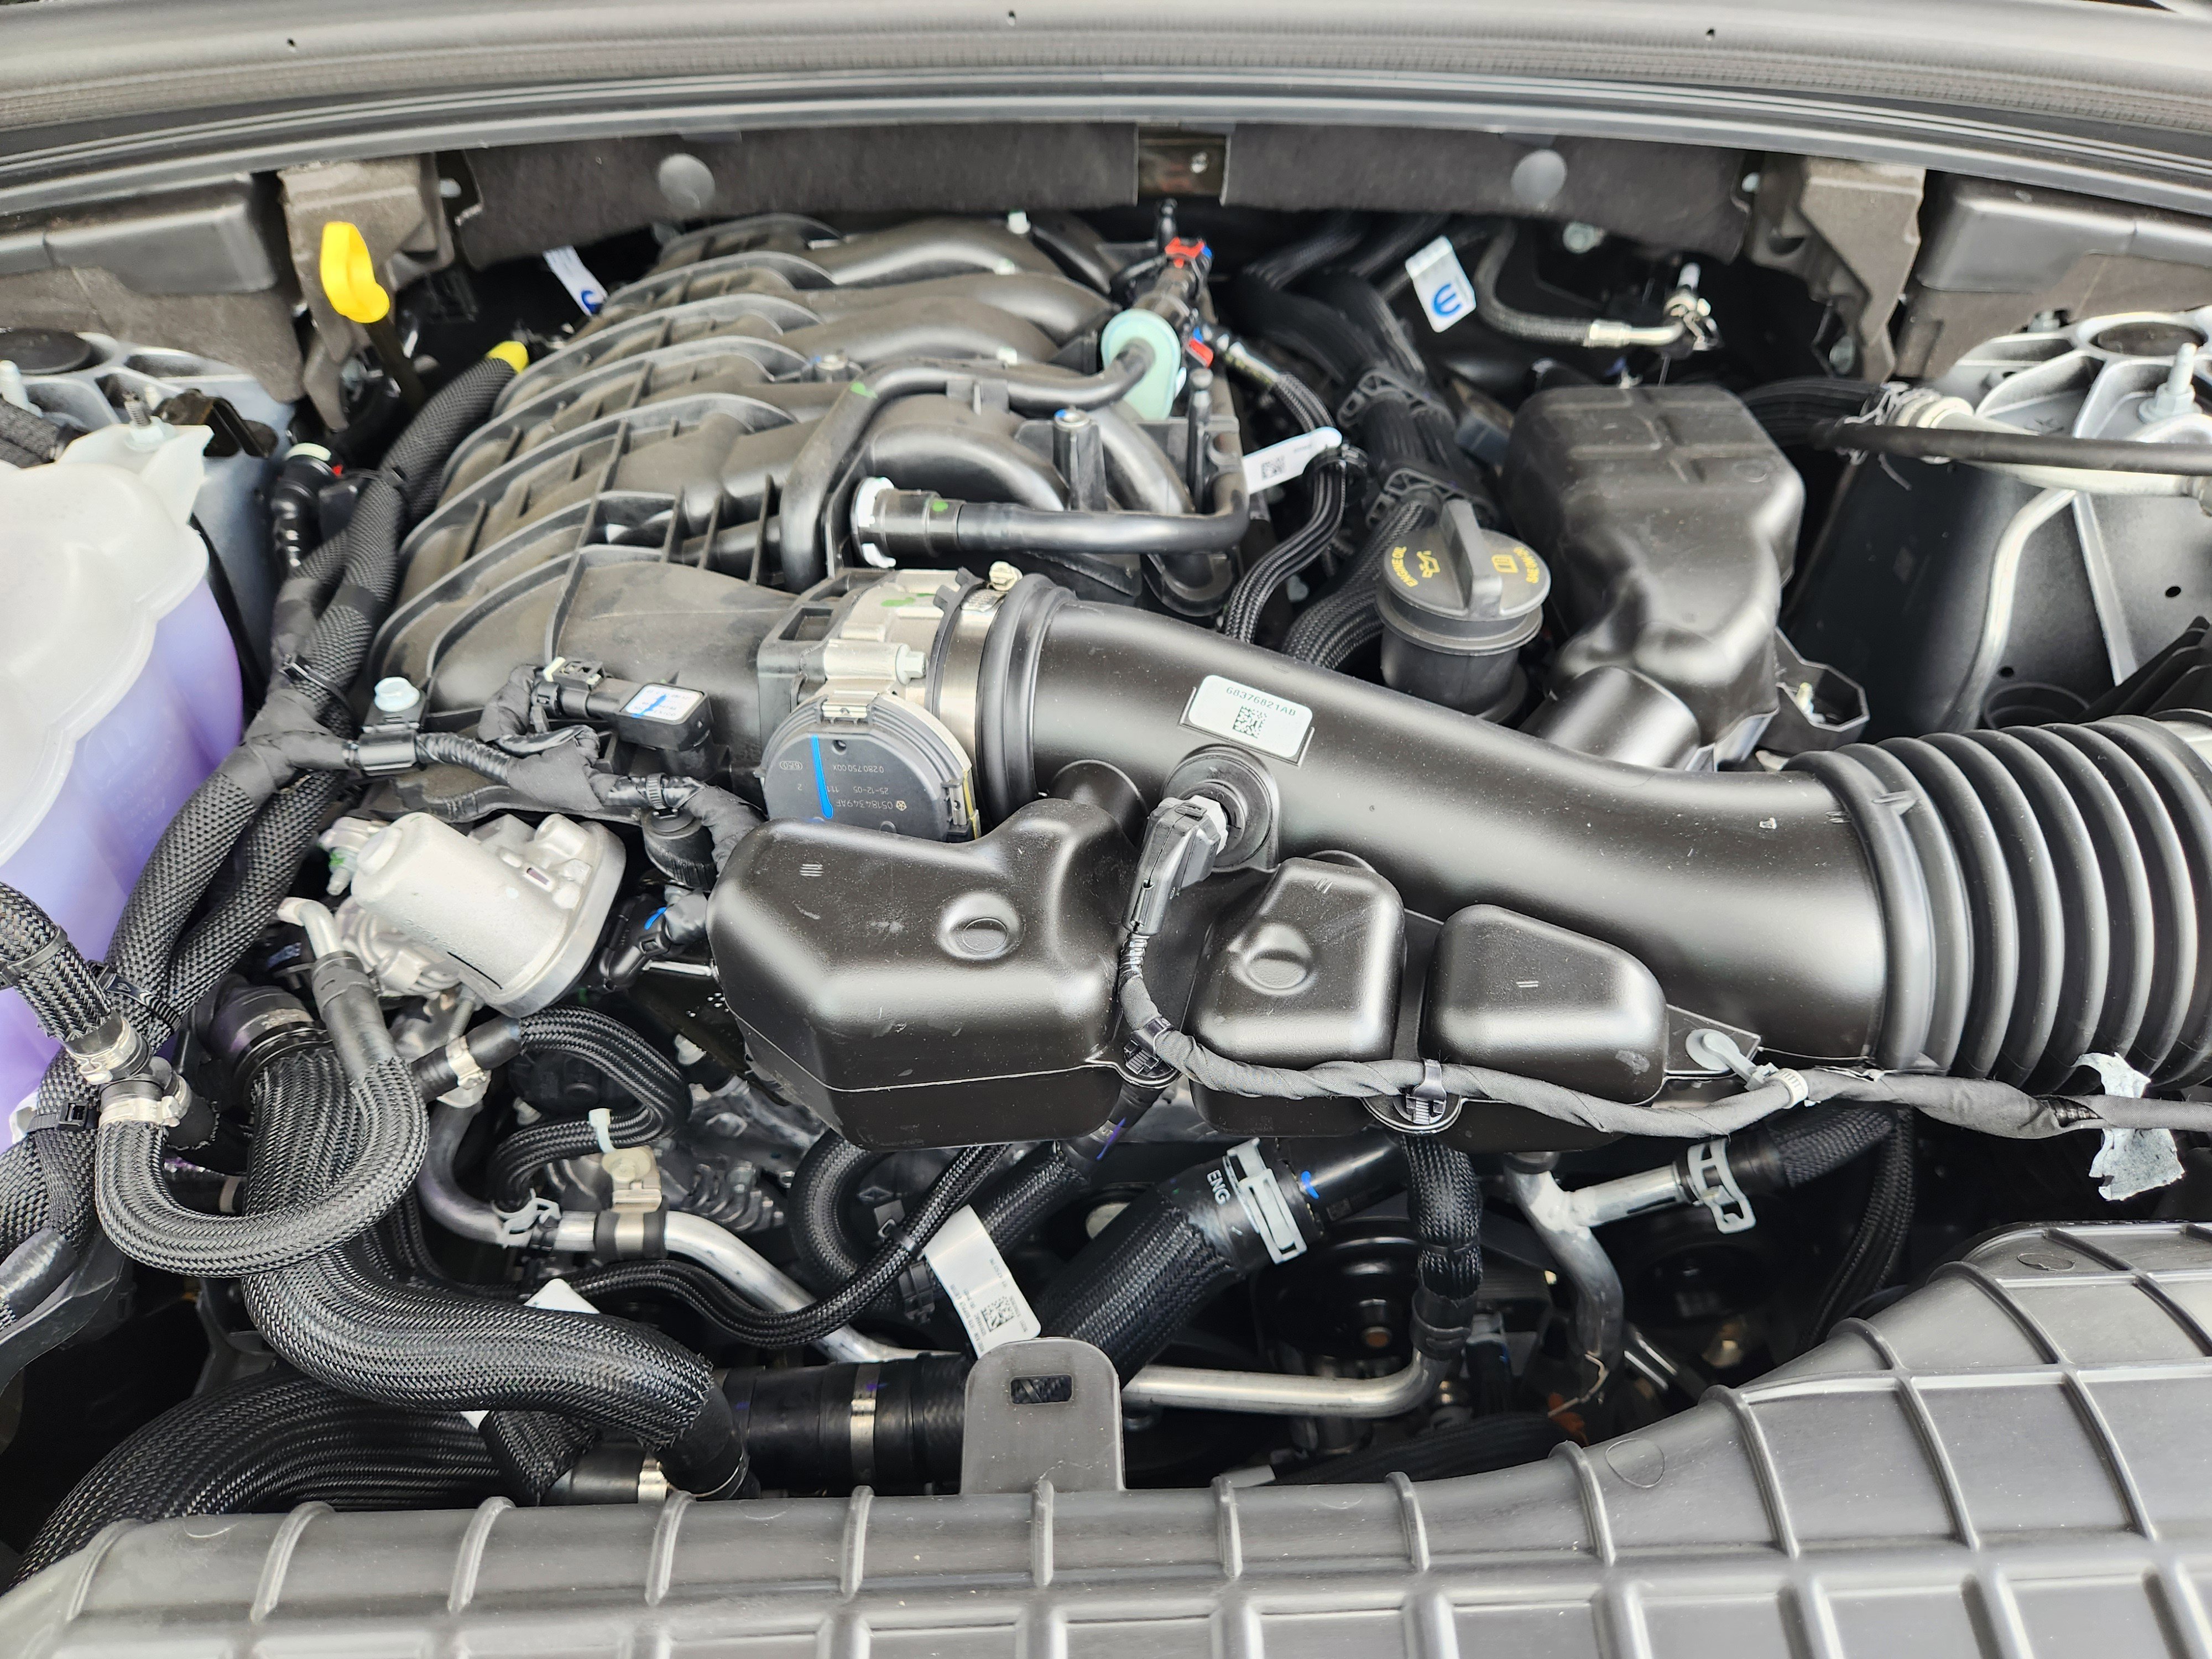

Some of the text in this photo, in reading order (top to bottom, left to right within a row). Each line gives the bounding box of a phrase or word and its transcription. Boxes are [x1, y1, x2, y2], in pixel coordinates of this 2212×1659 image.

[1391, 546, 1419, 587] ENGINE OIL
[1226, 687, 1296, 716] 68376821AB
[835, 799, 893, 809] 05184349AF
[853, 786, 889, 795] 25-12-05
[1207, 1169, 1231, 1206] ENG
